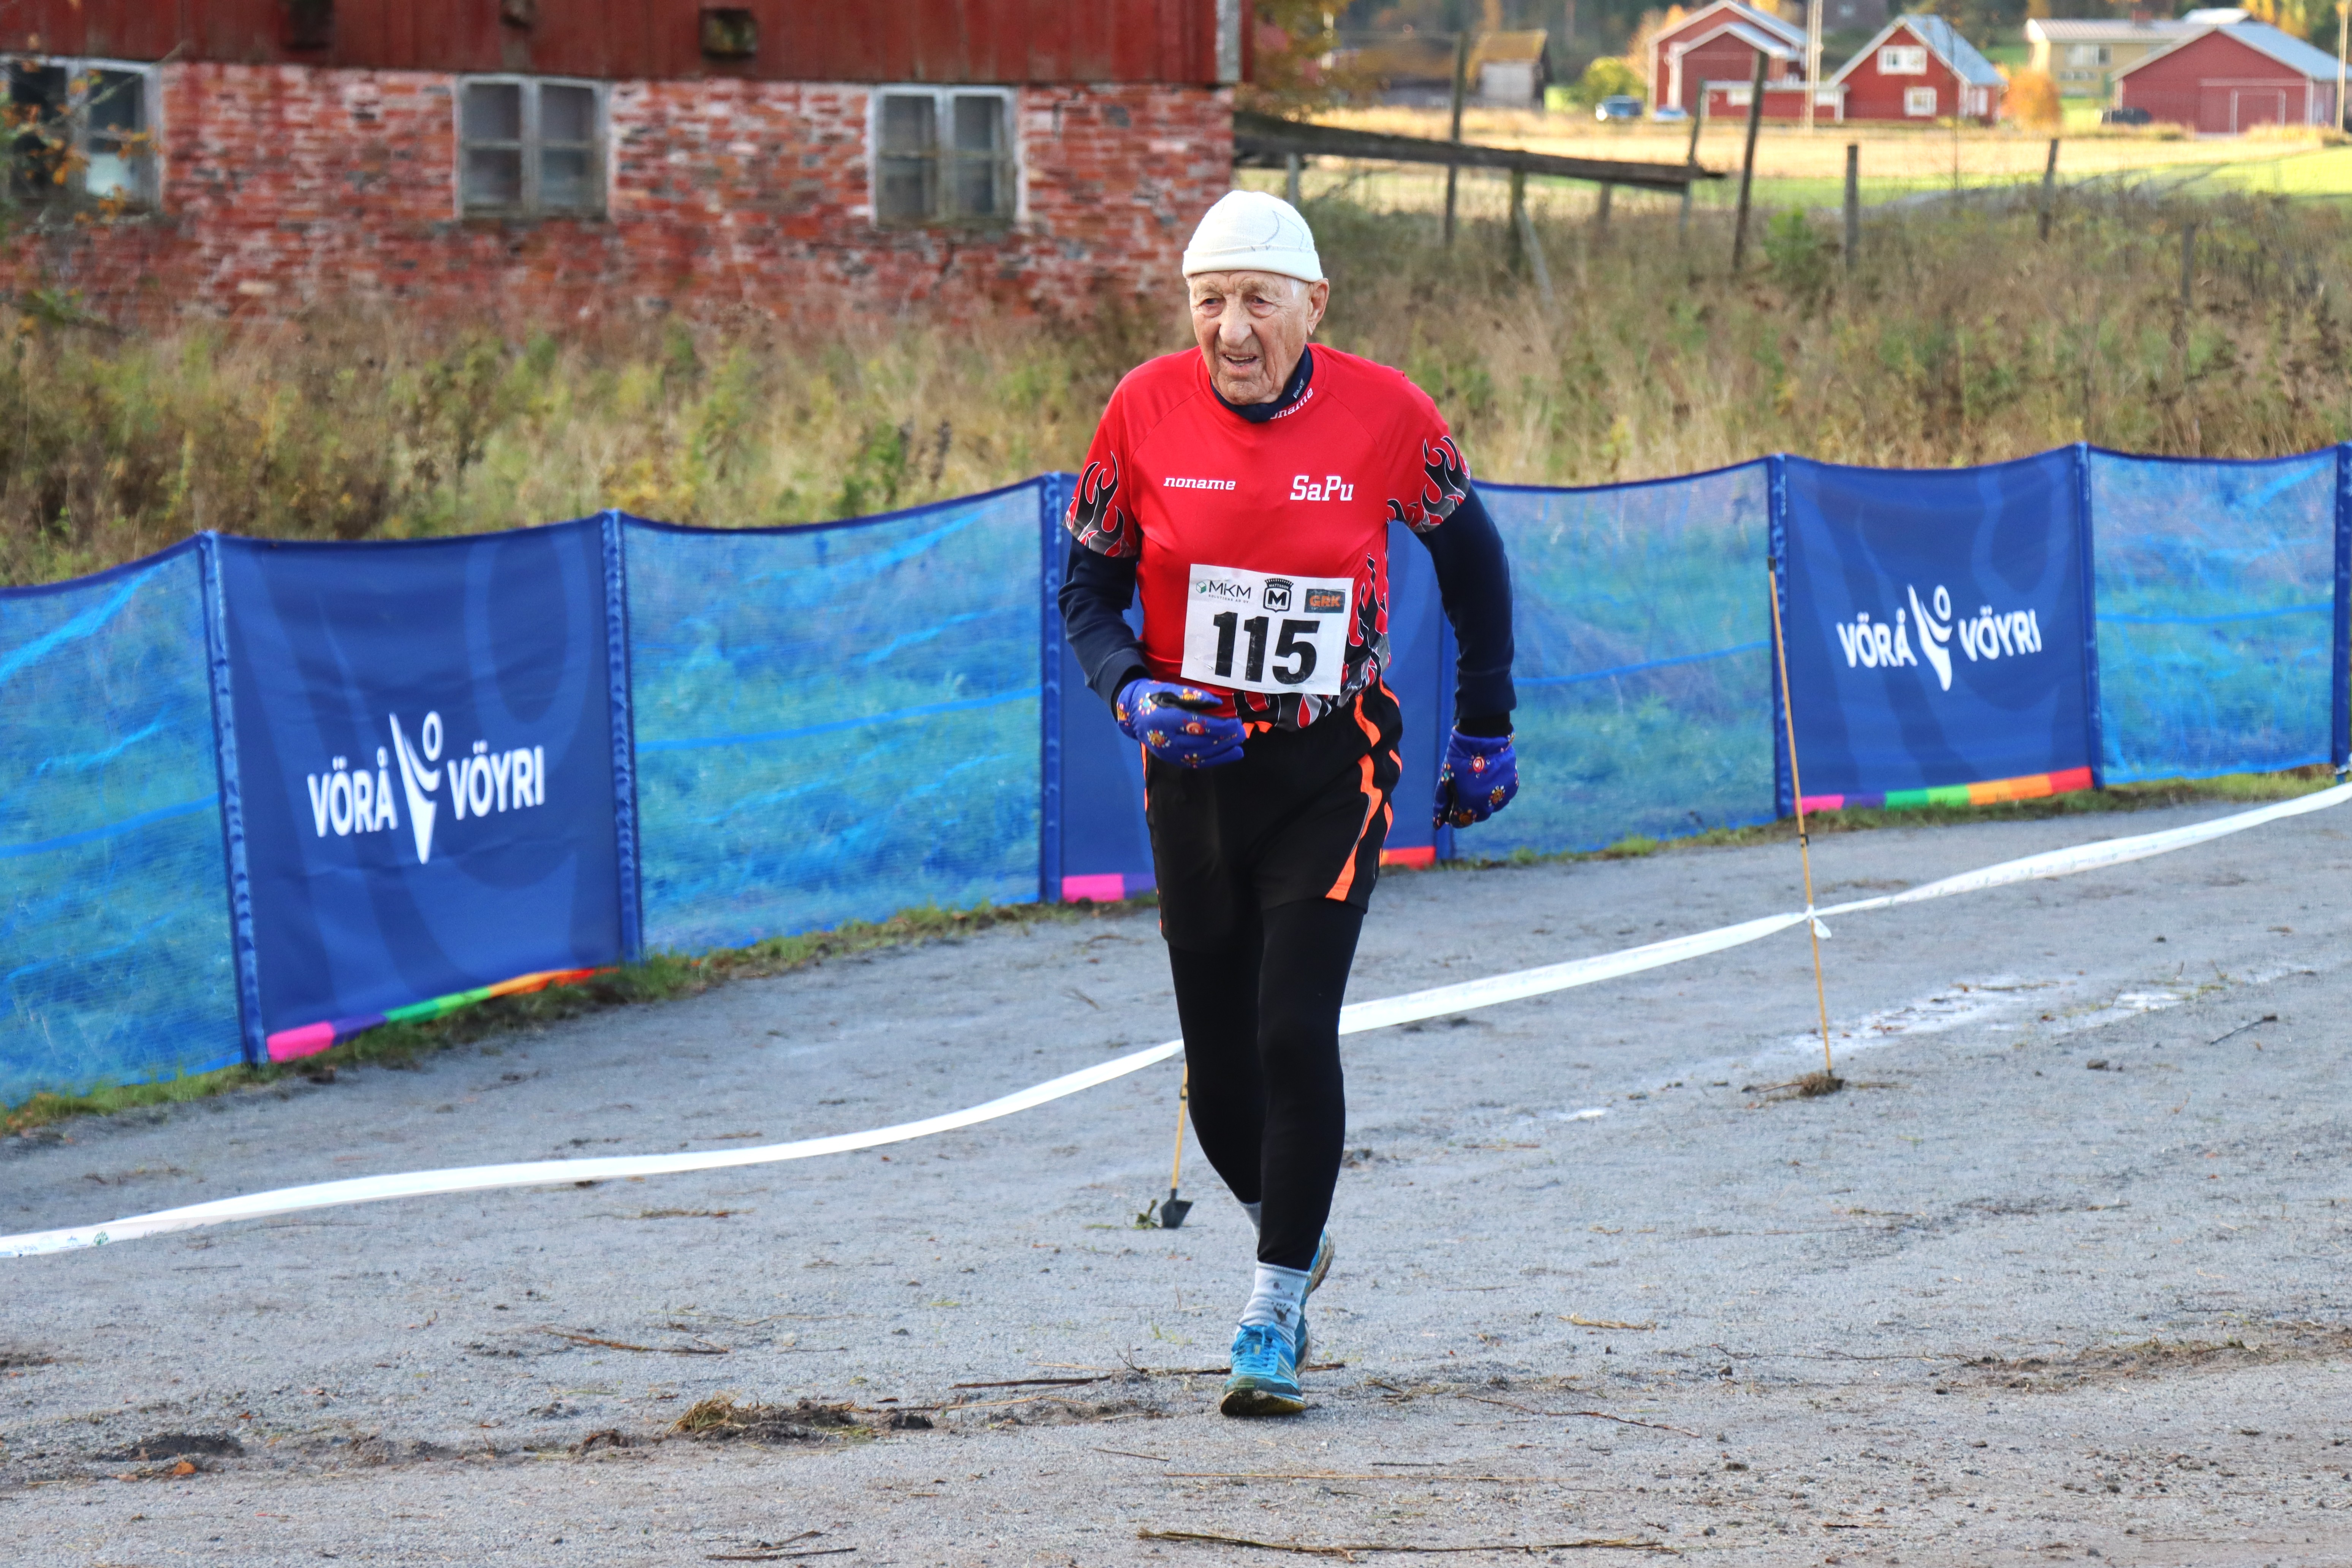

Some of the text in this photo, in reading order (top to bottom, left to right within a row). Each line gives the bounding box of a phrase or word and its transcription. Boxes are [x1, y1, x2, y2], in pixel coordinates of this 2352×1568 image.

[1163, 477, 1236, 490] noname
[1290, 475, 1354, 502] SaPu
[1208, 580, 1251, 599] MKM
[1268, 590, 1287, 606] M
[1309, 595, 1341, 607] GRK
[1836, 604, 2042, 668] VÖRÅ VÖYRI
[1213, 611, 1321, 685] 115
[307, 739, 545, 838] VÖRÅ VÖYRI
